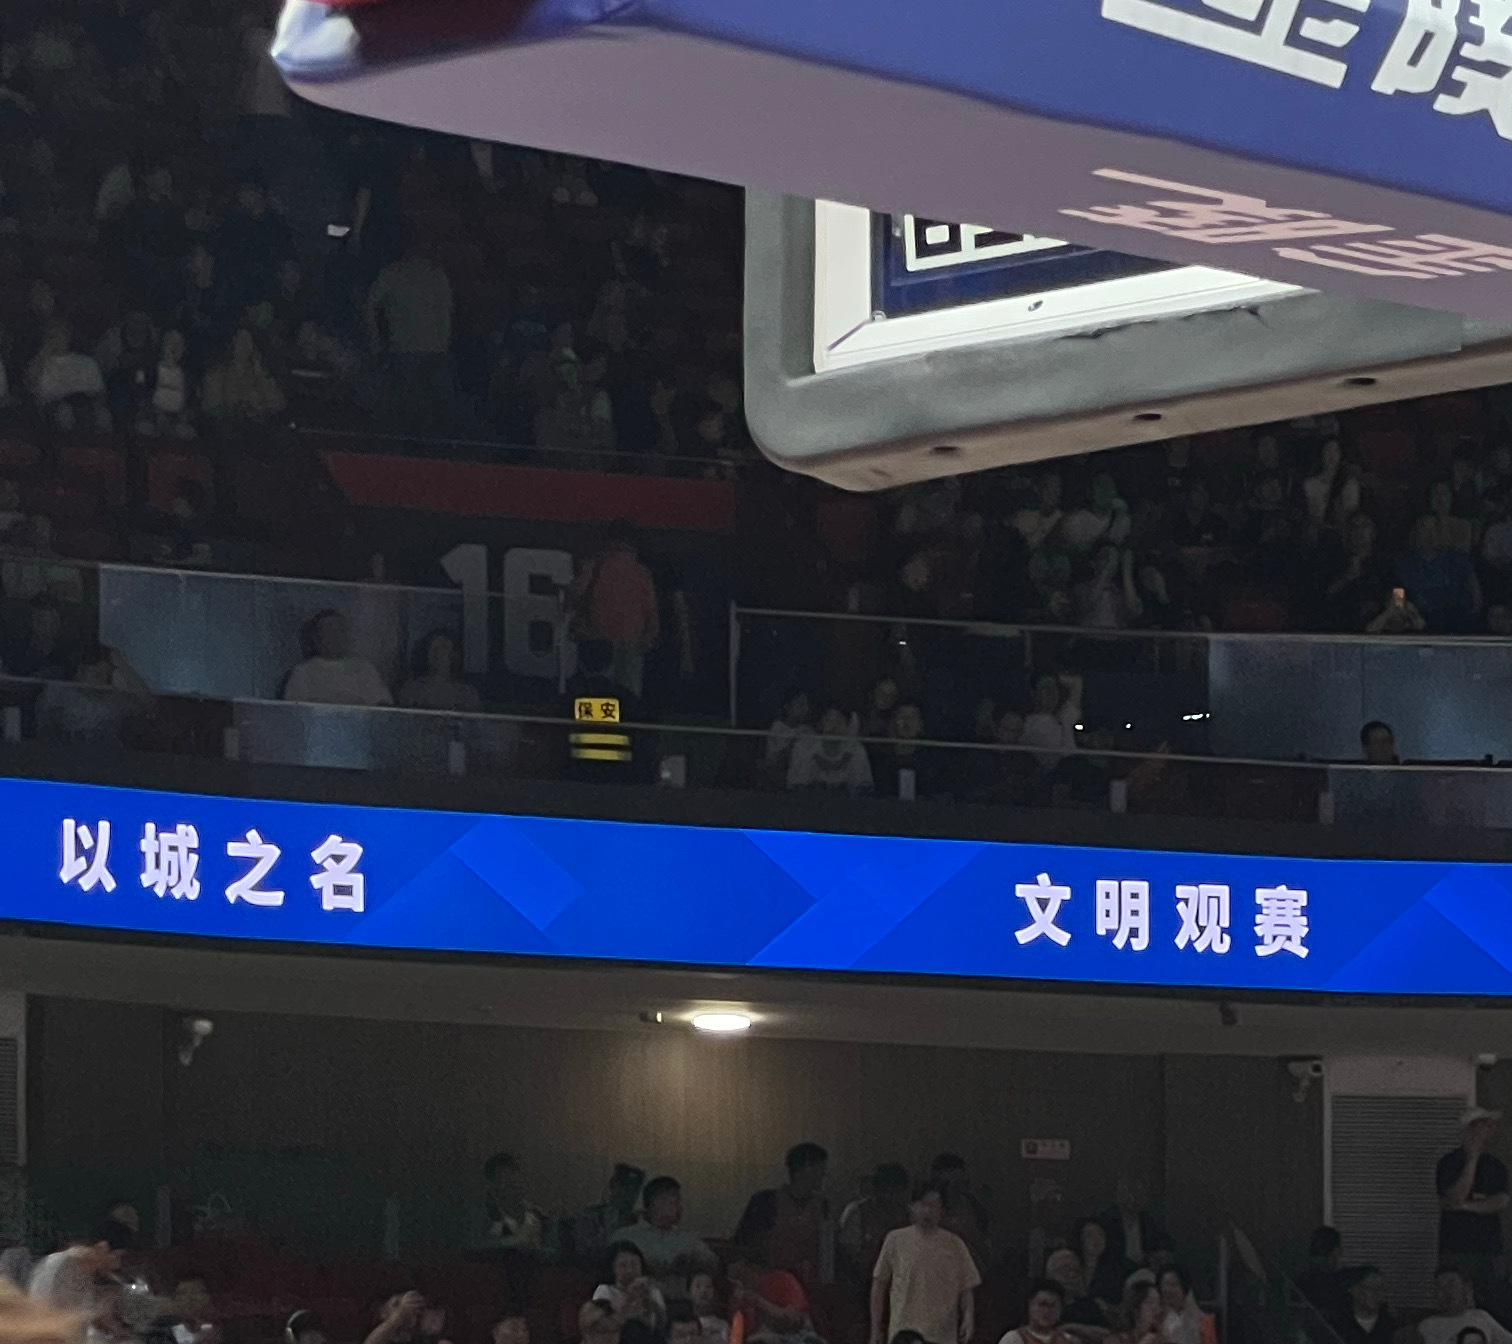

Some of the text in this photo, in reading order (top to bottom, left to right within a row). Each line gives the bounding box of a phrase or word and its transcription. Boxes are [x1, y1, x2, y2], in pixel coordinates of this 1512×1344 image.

[440, 542, 577, 678] 16
[578, 702, 616, 719] 保安
[58, 817, 366, 913] 以城之名
[1013, 872, 1311, 960] 文明观赛
